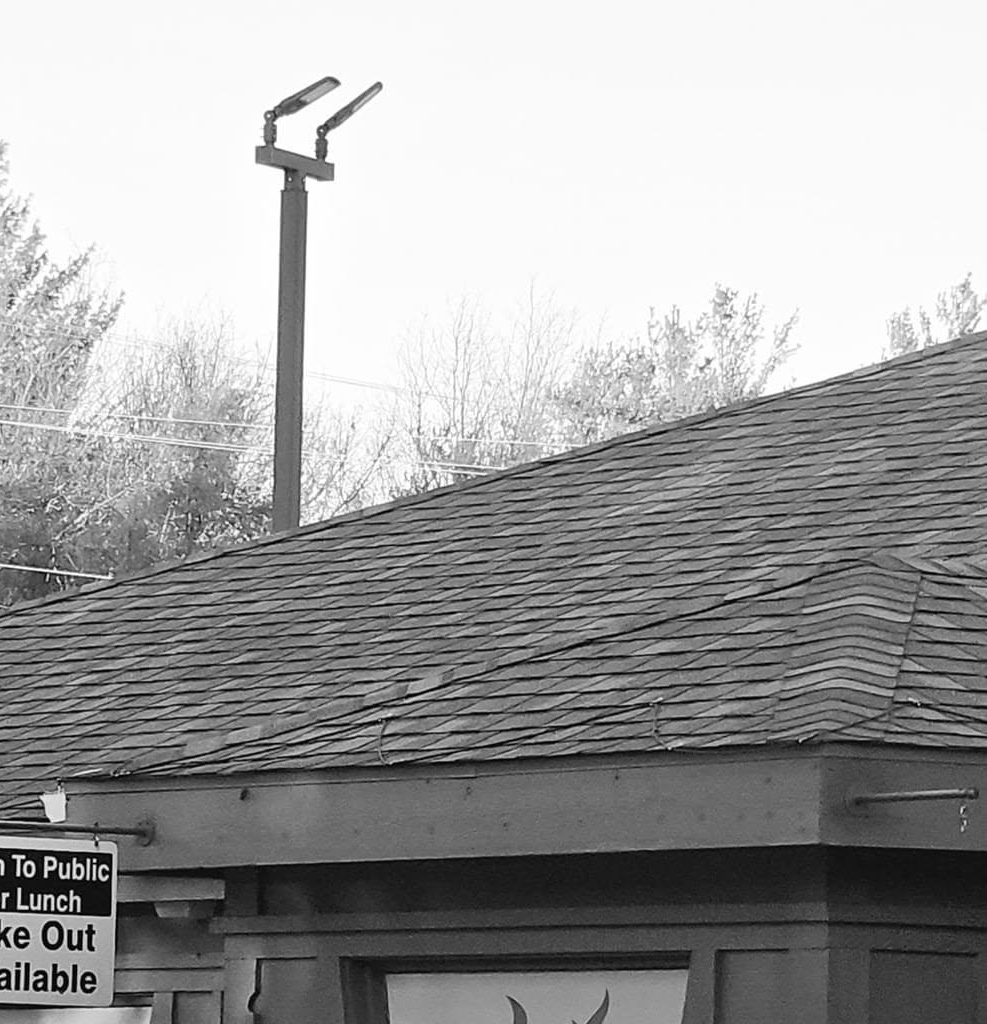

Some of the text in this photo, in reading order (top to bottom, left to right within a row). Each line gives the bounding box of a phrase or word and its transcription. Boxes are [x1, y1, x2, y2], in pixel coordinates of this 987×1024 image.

[11, 854, 36, 878] To
[42, 856, 110, 882] Public
[16, 887, 82, 913] Lunch
[40, 920, 96, 953] Out
